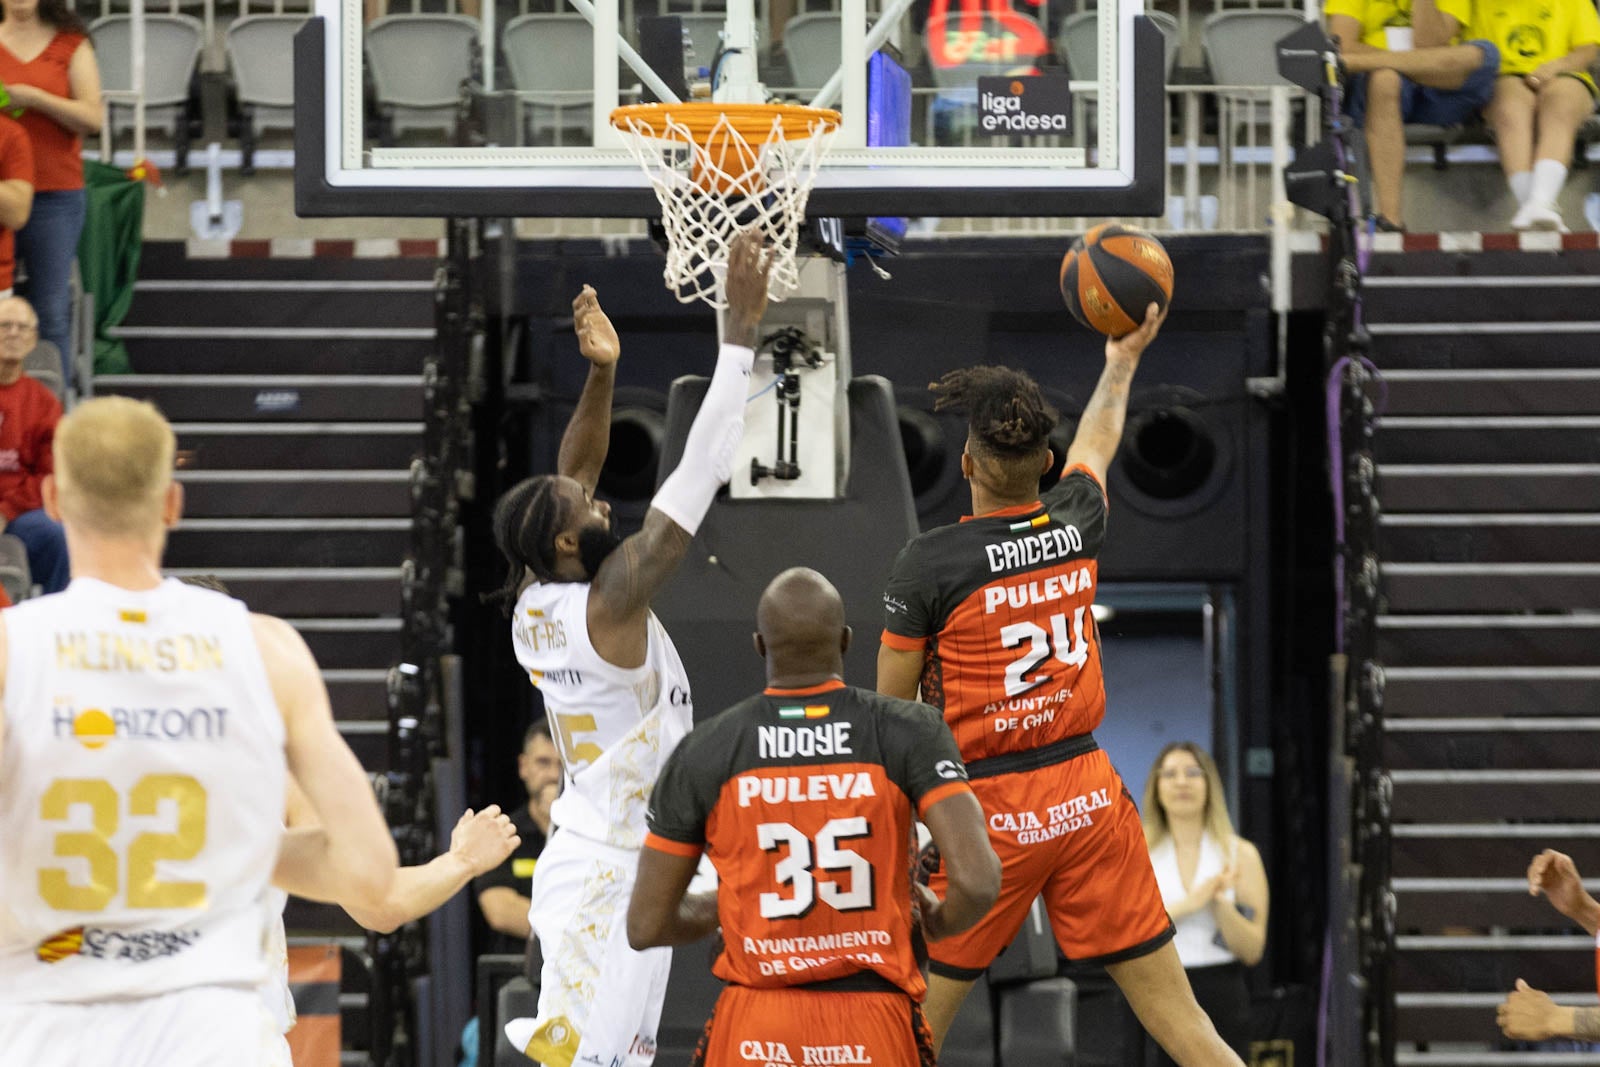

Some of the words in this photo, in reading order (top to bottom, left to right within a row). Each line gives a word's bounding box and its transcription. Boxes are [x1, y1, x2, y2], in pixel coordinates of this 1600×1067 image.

[982, 92, 1020, 114] liga
[982, 111, 1066, 130] endesa
[985, 525, 1083, 573] CAICEDO
[984, 567, 1093, 614] PULEVA
[1000, 605, 1088, 697] 24
[757, 722, 853, 759] NDOYE
[995, 717, 1018, 732] DE
[738, 772, 876, 807] PULEVA
[989, 811, 1043, 832] CAJA
[1047, 788, 1112, 825] RURAL
[37, 773, 208, 912] 32
[1017, 813, 1093, 845] GRANADA
[756, 816, 873, 920] 35
[743, 930, 891, 955] AYUNTAMIENTO
[759, 960, 787, 976] DE
[740, 1040, 795, 1064] CAJA
